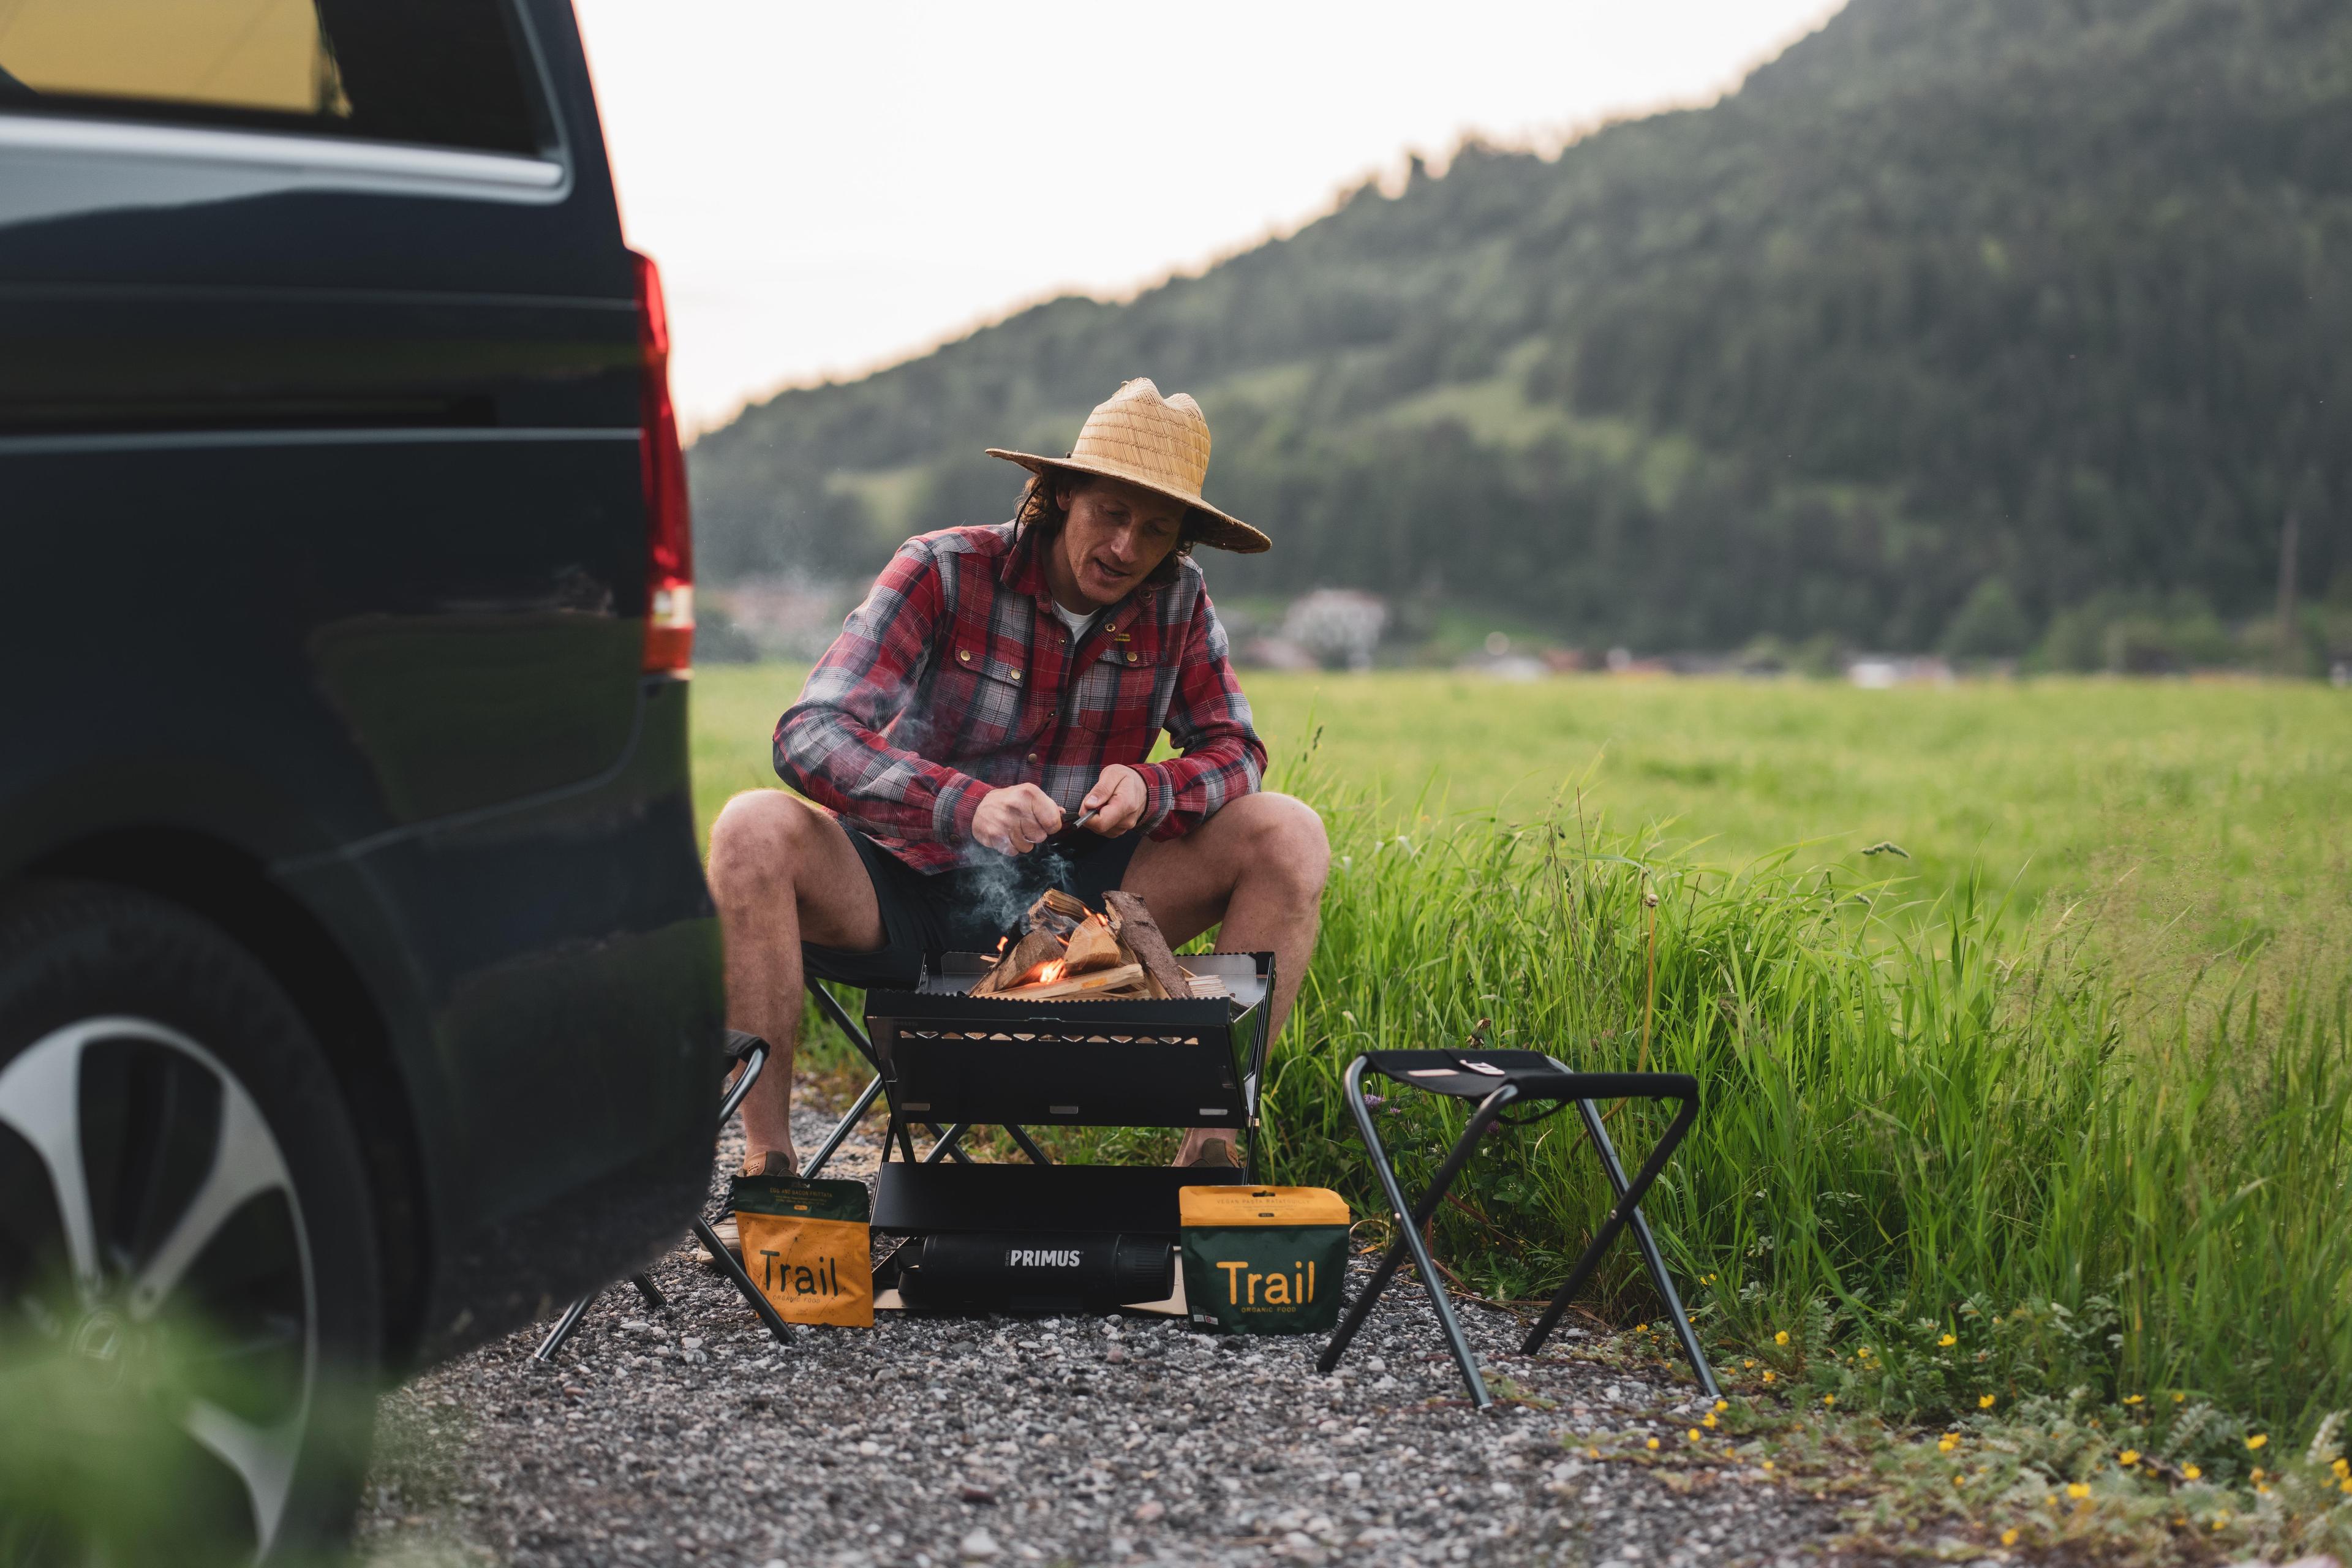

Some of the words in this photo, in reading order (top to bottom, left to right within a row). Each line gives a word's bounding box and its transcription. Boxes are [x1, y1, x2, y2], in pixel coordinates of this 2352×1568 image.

[760, 1249, 839, 1297] Trail
[1010, 1250, 1080, 1267] PRIMUS
[1216, 1261, 1315, 1305] Trail
